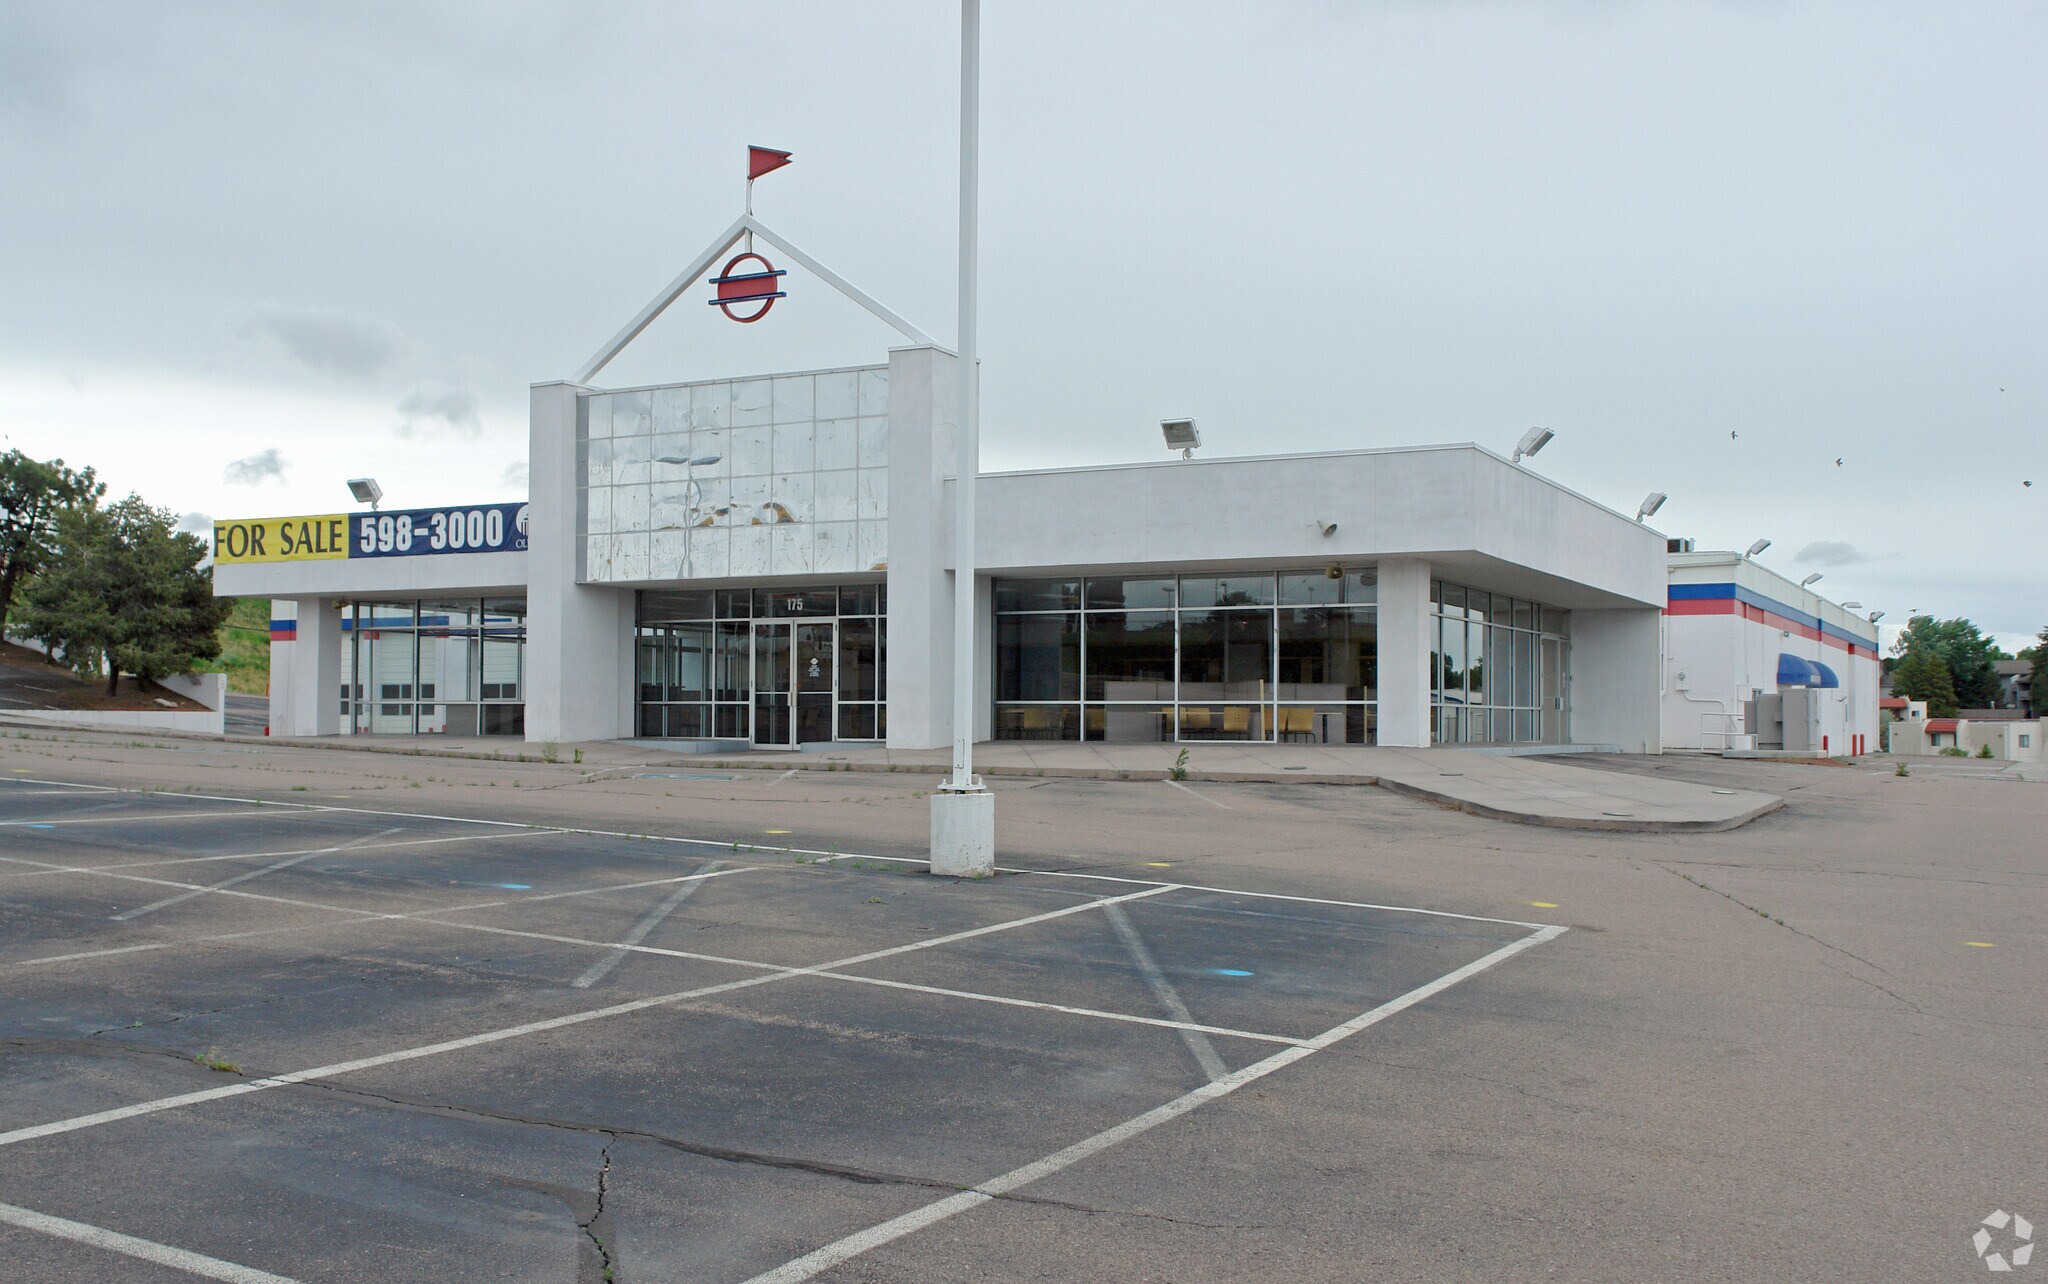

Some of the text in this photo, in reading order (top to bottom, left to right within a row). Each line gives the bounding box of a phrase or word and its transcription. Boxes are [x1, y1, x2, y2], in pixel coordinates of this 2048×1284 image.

[213, 520, 342, 558] FOR SALE
[360, 509, 503, 553] 598-3000
[787, 598, 803, 611] 175
